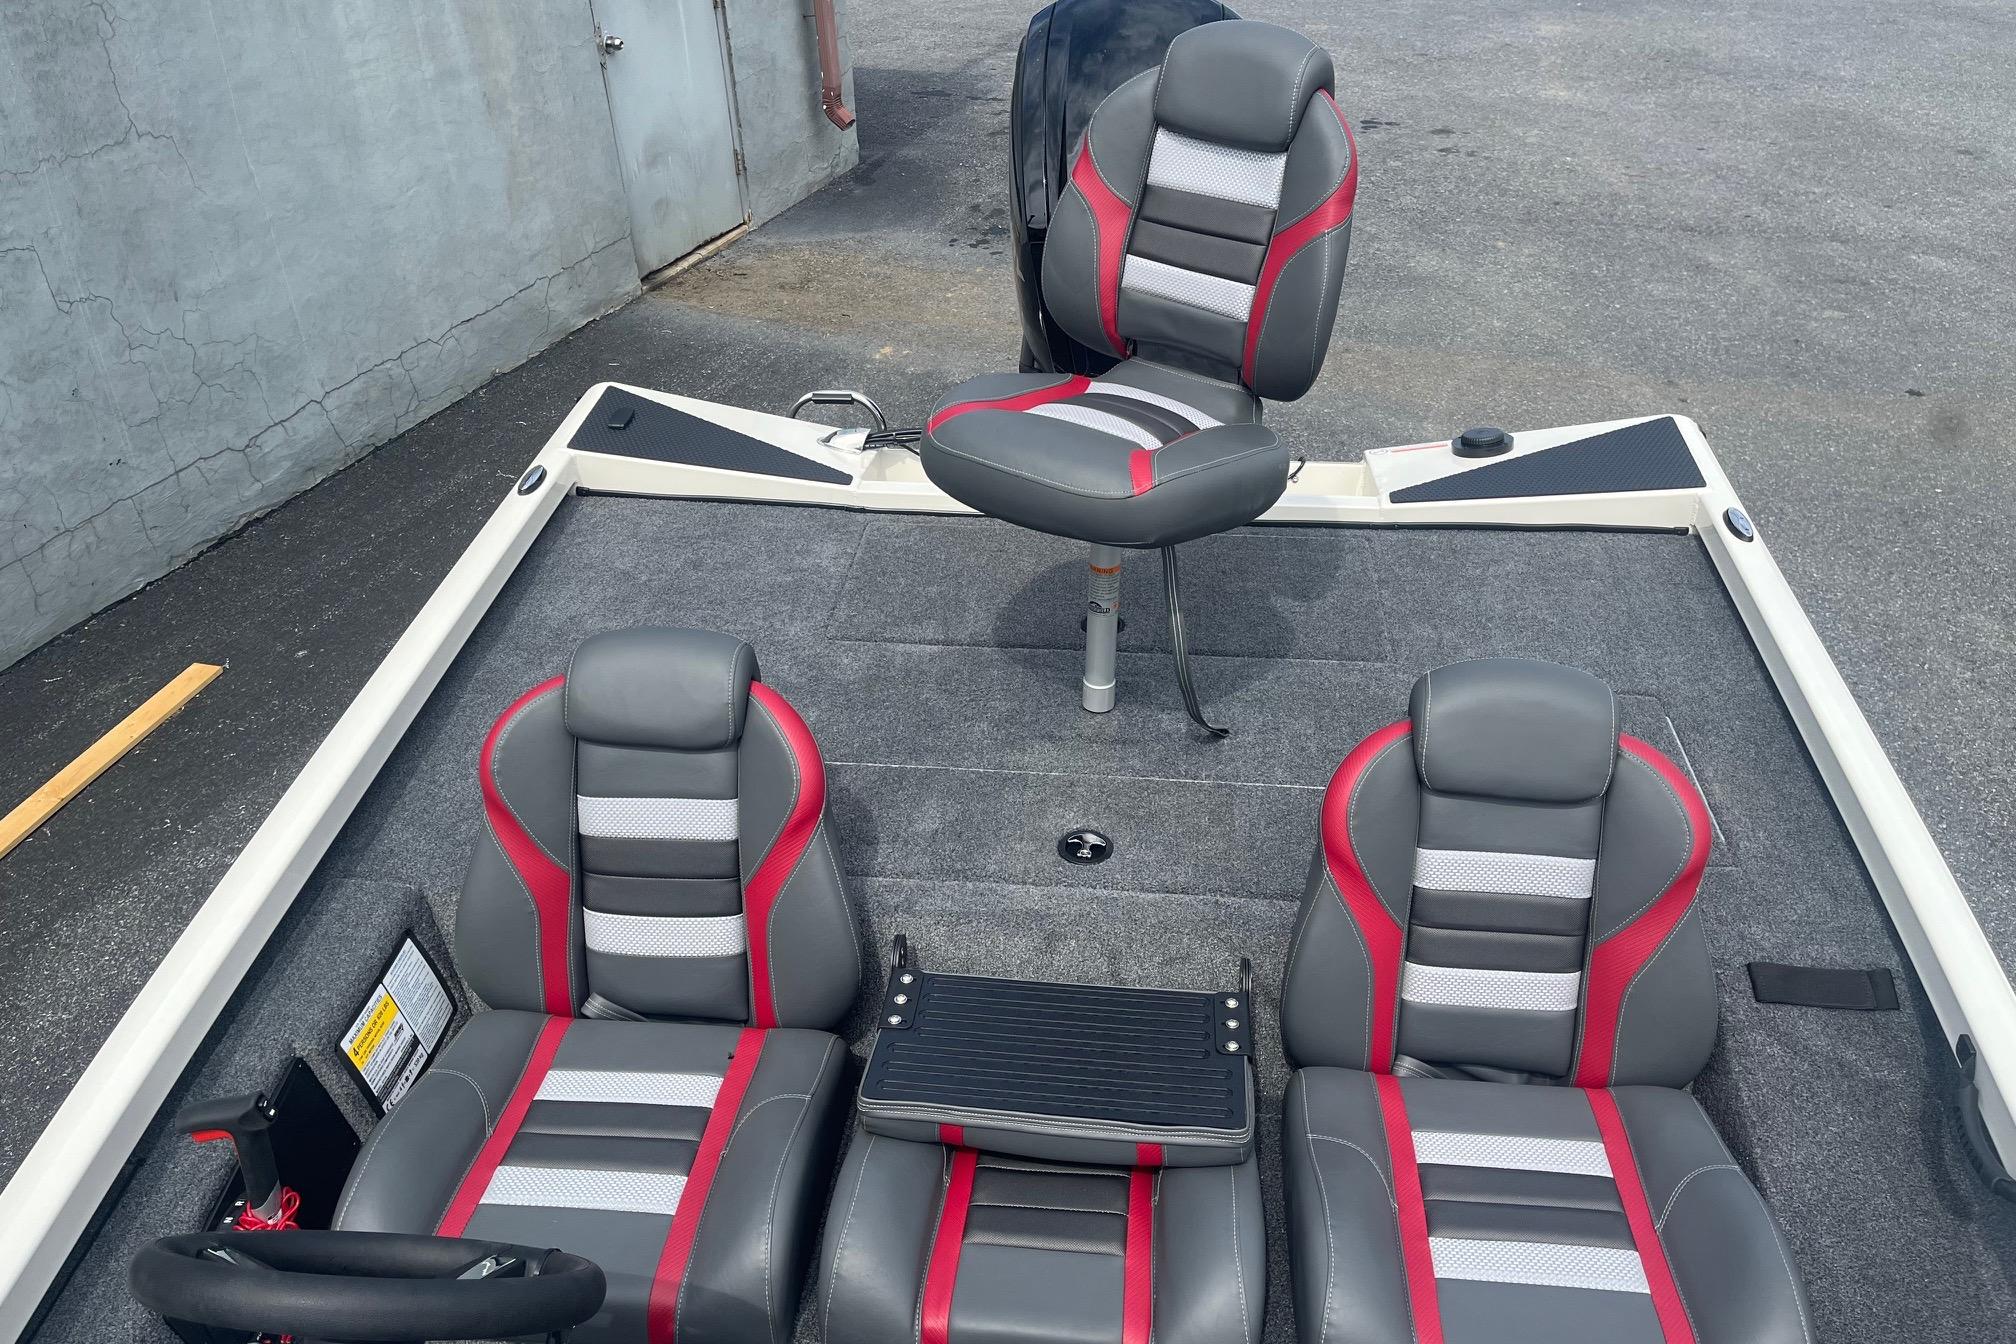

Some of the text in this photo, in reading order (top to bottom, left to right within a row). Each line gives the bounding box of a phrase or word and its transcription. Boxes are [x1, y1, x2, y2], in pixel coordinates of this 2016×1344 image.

[349, 1020, 365, 1044] MAXIMUM
[365, 994, 382, 1021] CAPACITIES
[352, 1046, 359, 1057] 4
[357, 1026, 373, 1051] PERSONS
[371, 1018, 378, 1028] OR
[223, 1216, 234, 1224] N
